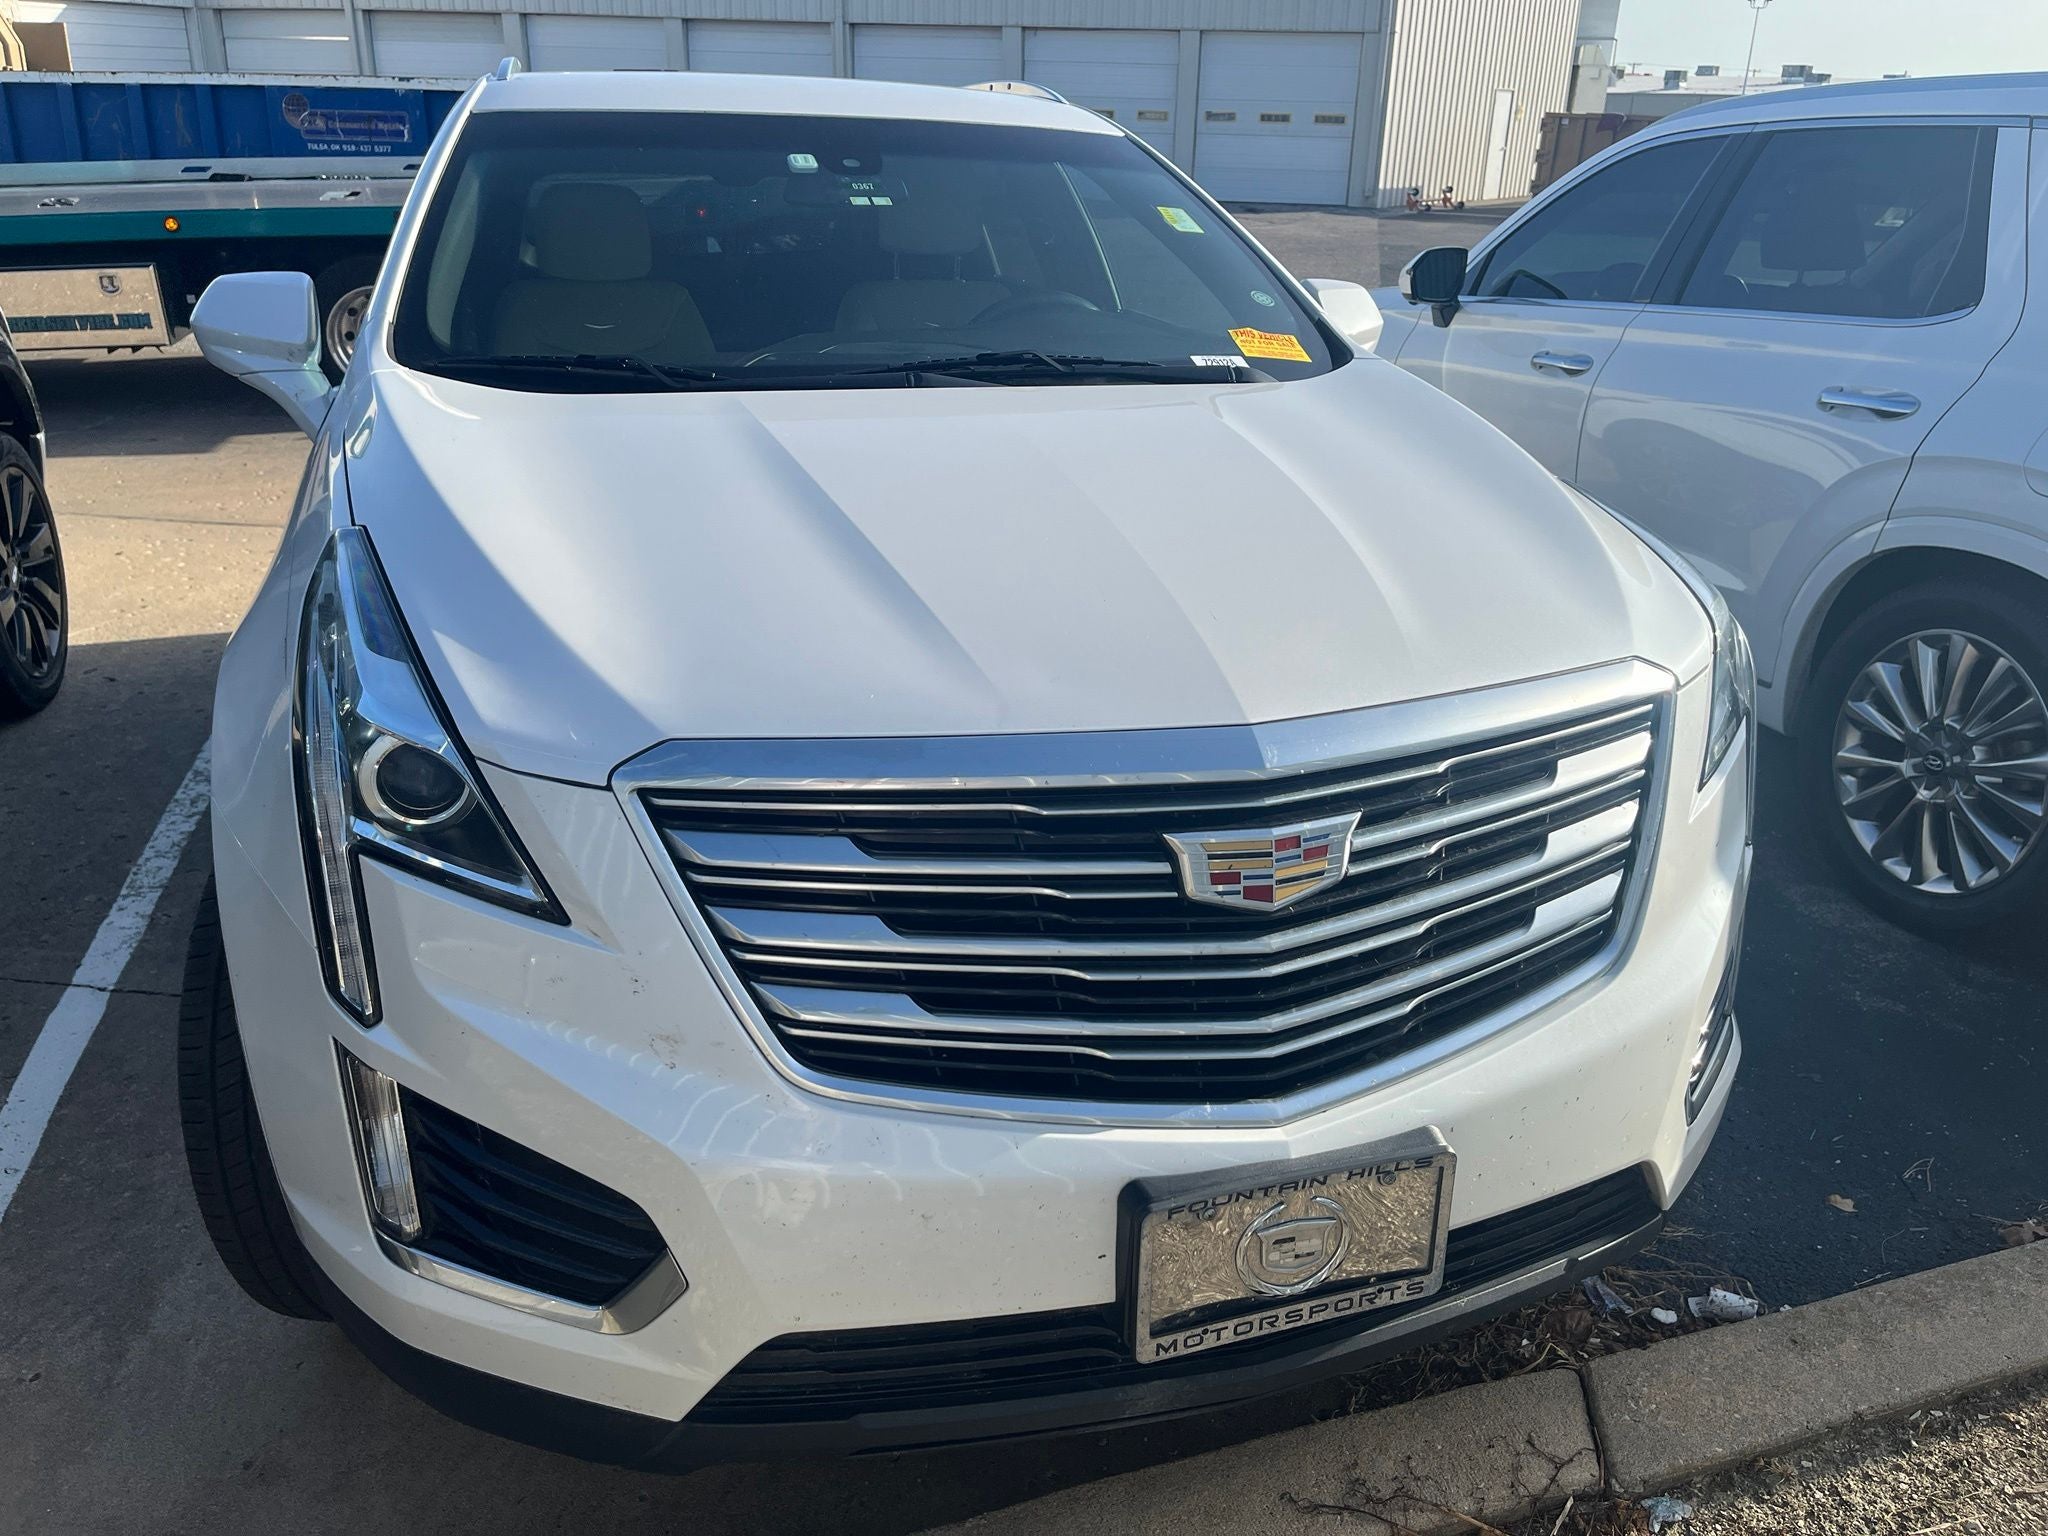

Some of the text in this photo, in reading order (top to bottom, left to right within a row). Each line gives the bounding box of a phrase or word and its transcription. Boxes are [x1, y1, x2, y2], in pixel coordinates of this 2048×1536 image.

[1232, 329, 1255, 339] THIS
[1167, 1156, 1435, 1220] FOUNTAIN HILLS
[1155, 1280, 1425, 1357] MOTORSPORTS
